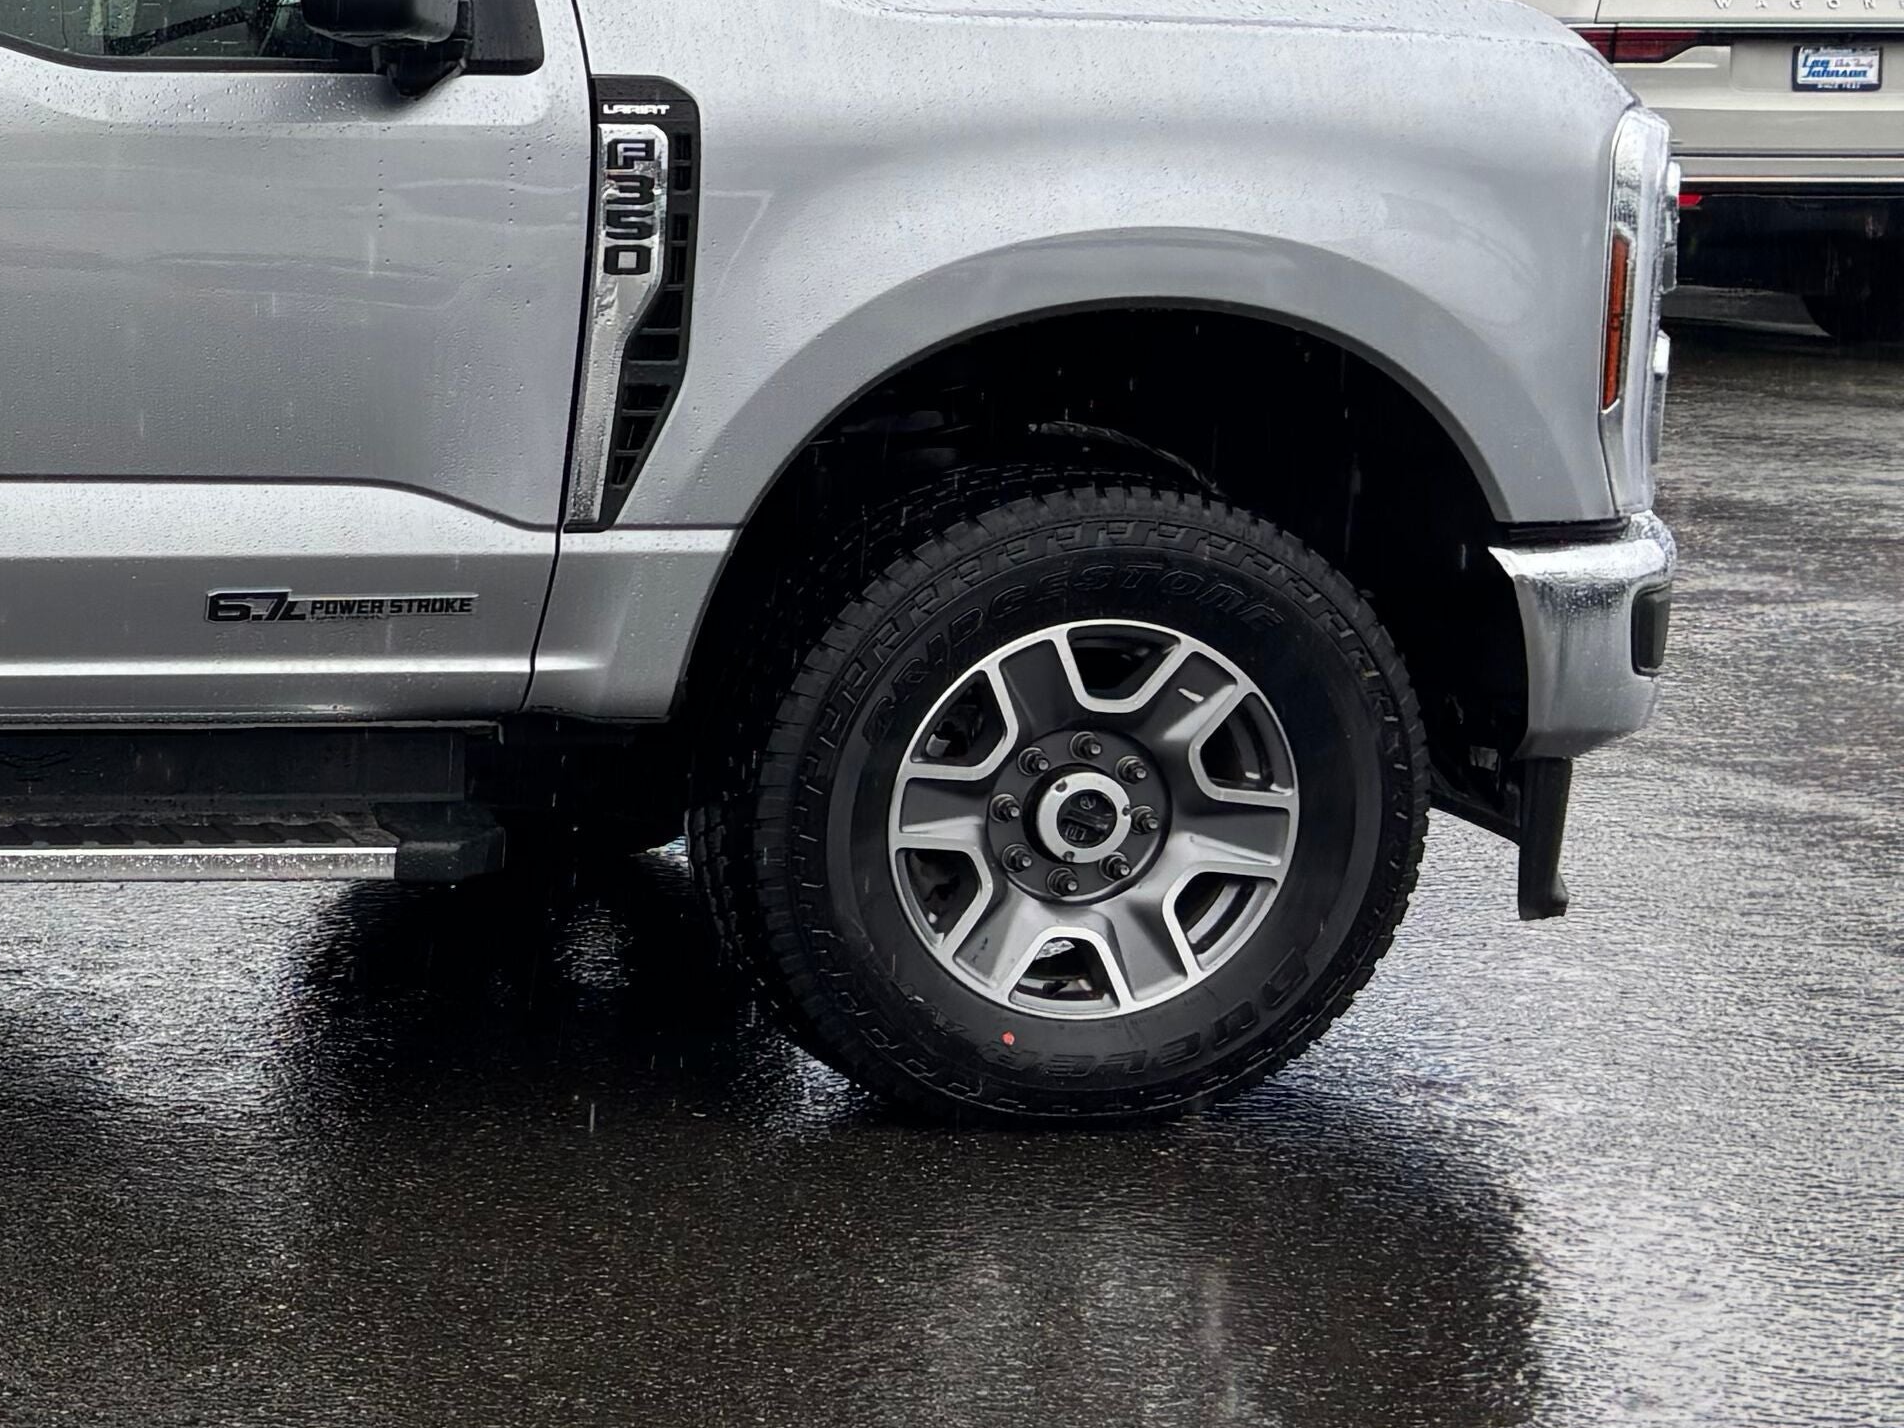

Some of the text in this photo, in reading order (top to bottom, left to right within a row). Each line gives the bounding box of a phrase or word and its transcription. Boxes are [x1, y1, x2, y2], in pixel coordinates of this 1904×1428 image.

[602, 104, 671, 115] LARIAT
[205, 588, 307, 622] 6.7L
[309, 599, 384, 616] POWER
[389, 597, 475, 614] STROKE
